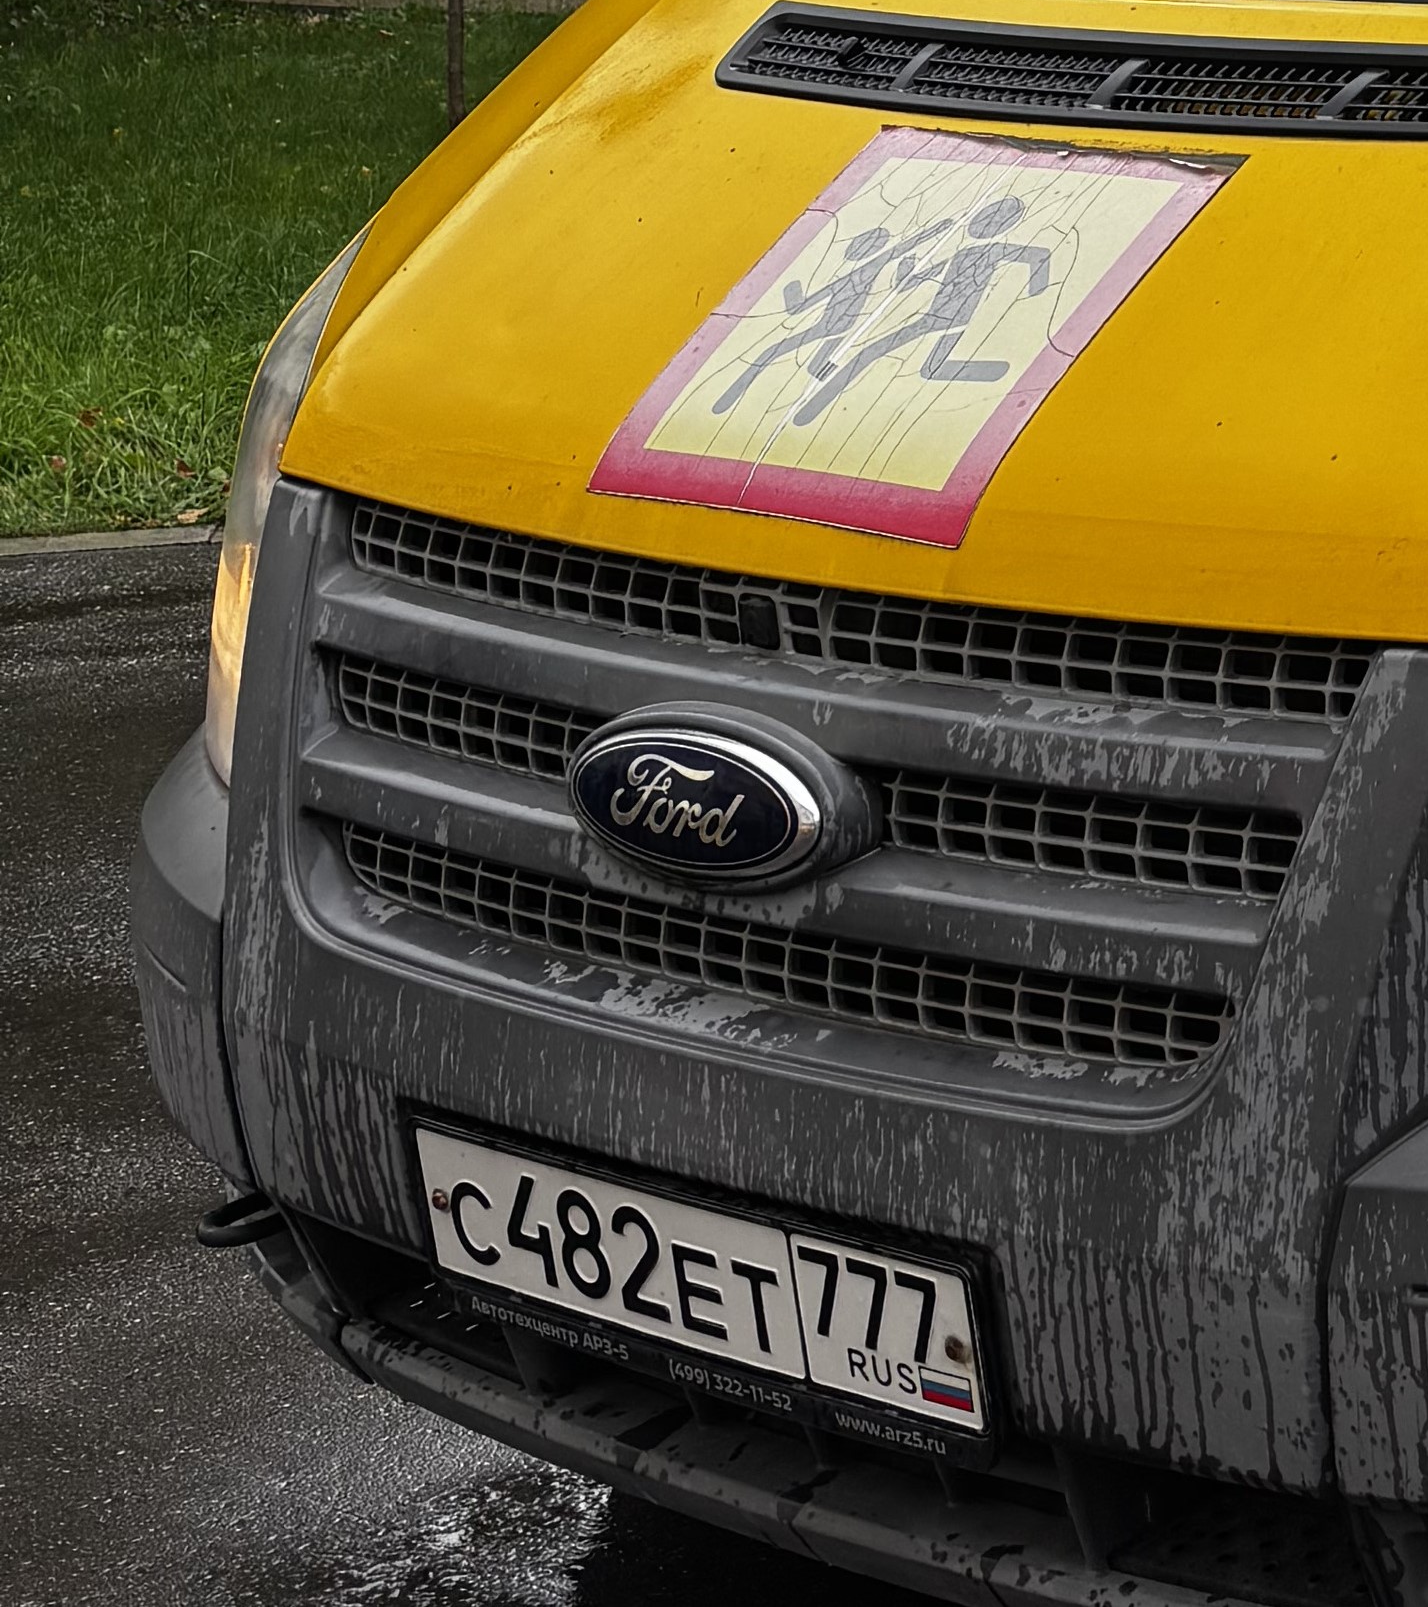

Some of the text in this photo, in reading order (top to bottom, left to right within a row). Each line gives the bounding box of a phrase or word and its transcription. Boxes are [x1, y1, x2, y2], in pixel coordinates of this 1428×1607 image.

[610, 754, 745, 847] Ford
[450, 1174, 937, 1364] С482ЕТ 777
[471, 1296, 629, 1360] Автотехцентр АРЗ-5
[669, 1359, 793, 1412] (499) 322-11-52
[847, 1347, 918, 1394] RUS
[835, 1411, 947, 1455] www.arz5.ru
